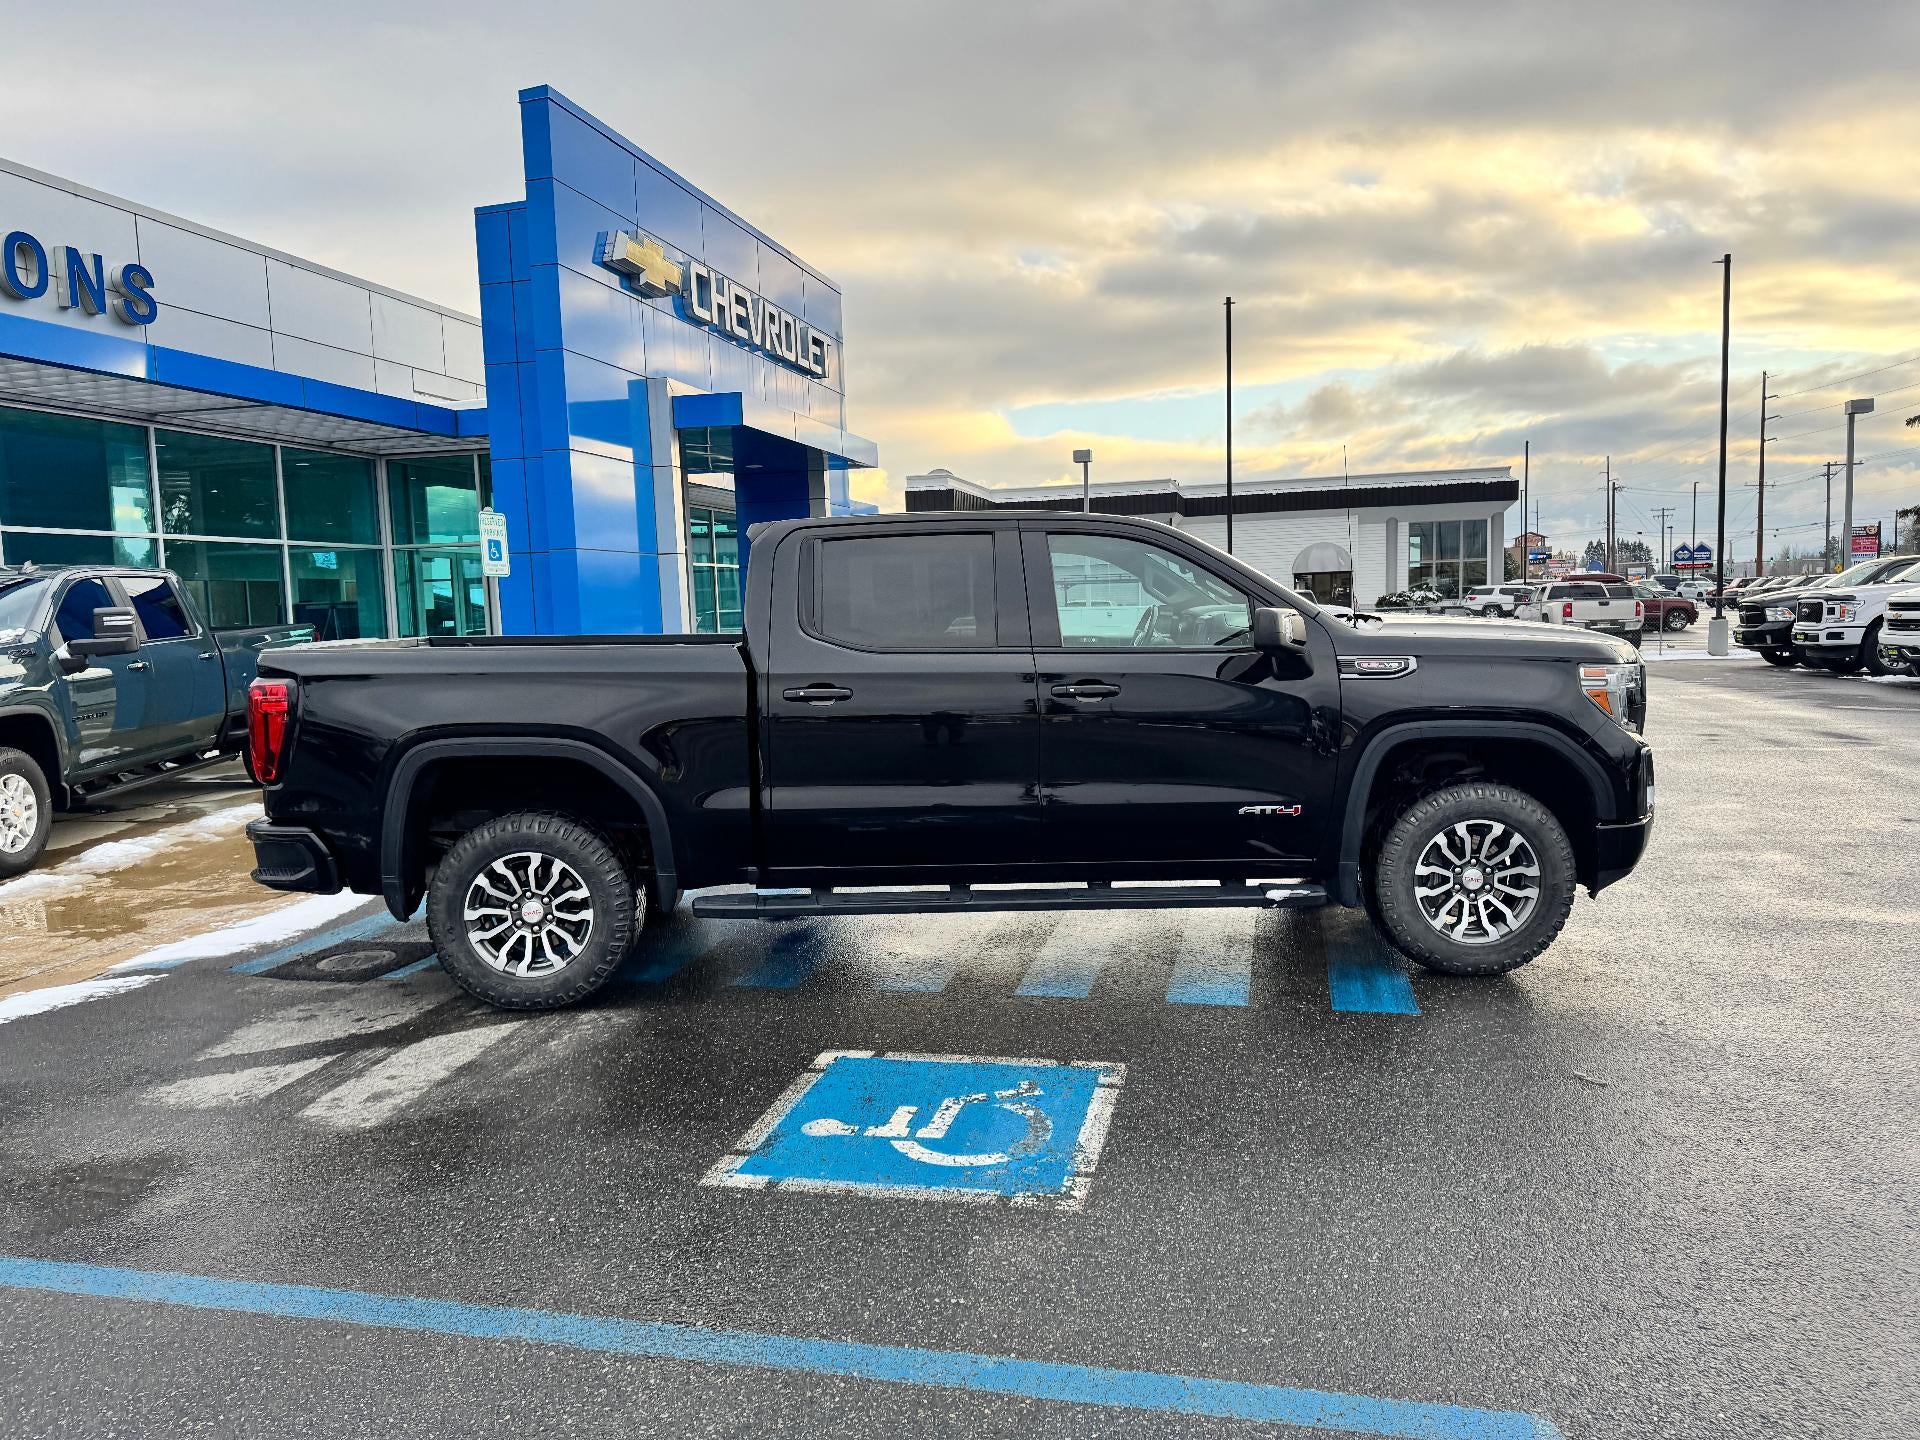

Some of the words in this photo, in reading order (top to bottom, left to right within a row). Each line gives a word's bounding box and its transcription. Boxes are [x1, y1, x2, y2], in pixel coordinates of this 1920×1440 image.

[3, 231, 158, 325] ONS
[690, 261, 831, 377] CHEVROLET
[1239, 805, 1301, 816] AT4
